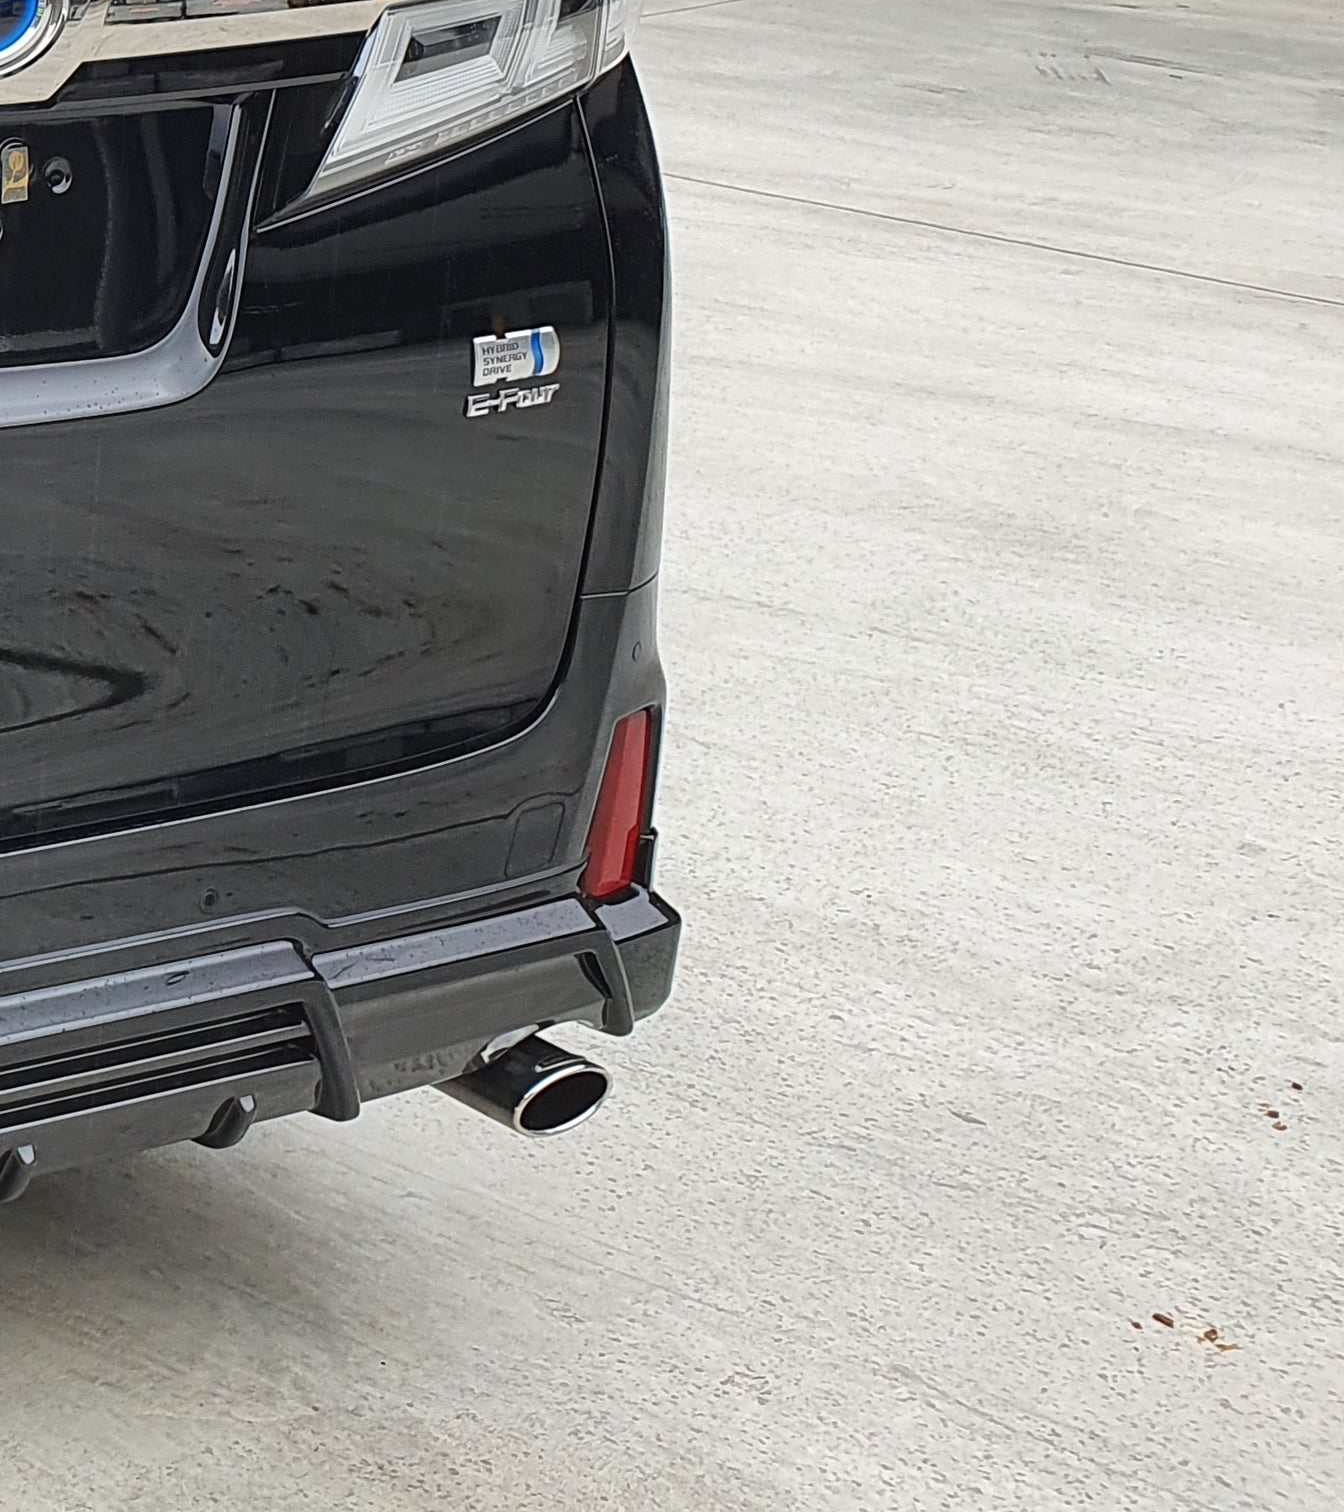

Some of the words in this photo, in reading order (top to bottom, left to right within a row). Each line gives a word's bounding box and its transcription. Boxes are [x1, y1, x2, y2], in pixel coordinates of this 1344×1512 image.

[481, 341, 520, 356] HYBRID
[482, 351, 529, 367] SYNERGY
[482, 364, 513, 377] DRIVE
